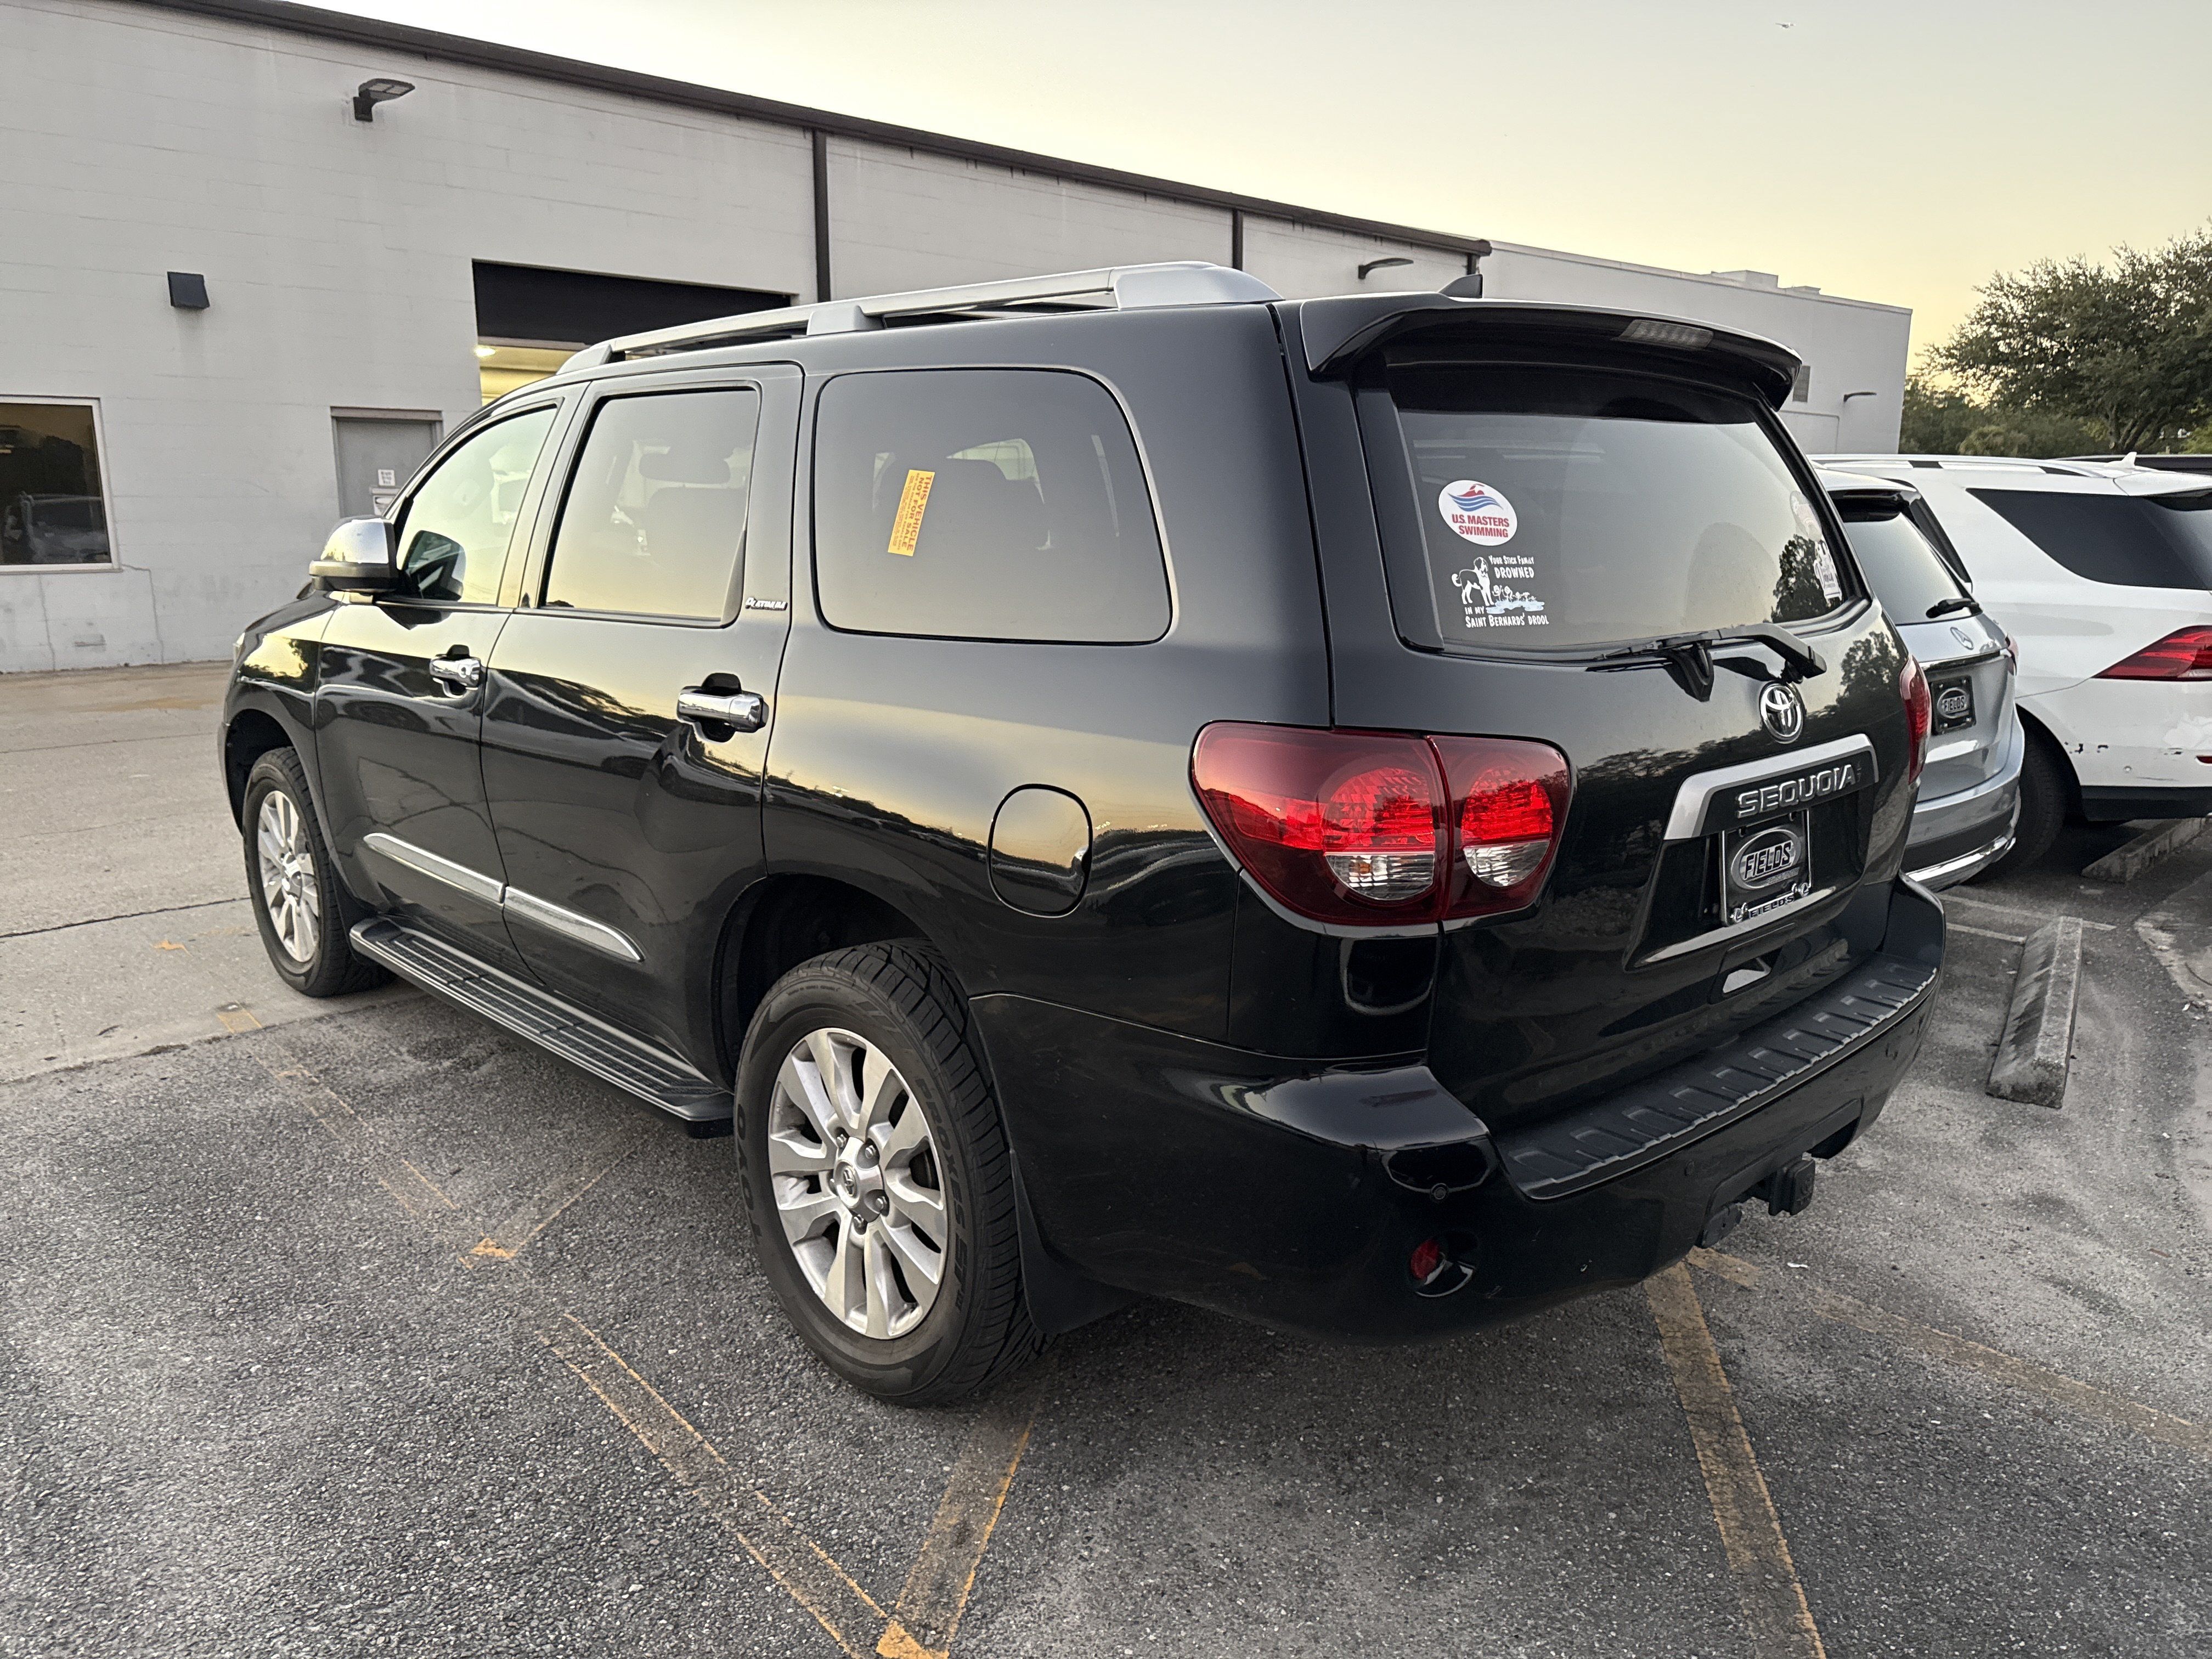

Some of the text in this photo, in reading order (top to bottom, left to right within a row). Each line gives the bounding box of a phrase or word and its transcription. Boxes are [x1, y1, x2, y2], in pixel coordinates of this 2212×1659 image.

[915, 477, 924, 496] NOT
[919, 475, 932, 500] THIS
[909, 499, 918, 519] FOR
[906, 503, 924, 551] VEHICLE
[1468, 515, 1510, 527] MASTERS
[901, 522, 912, 548] SALE
[1459, 526, 1509, 538] SWIMMING
[1494, 567, 1534, 578] DROWNED
[1475, 606, 1485, 614] MY
[1465, 616, 1487, 628] SAINT
[1528, 615, 1549, 625] DROOL
[1944, 696, 1965, 712] FIELDS
[1736, 764, 1859, 819] SEQUOIA
[1745, 842, 1792, 879] FIELDS
[1750, 894, 1795, 918] FIELDS
[916, 1079, 966, 1229] PROXES
